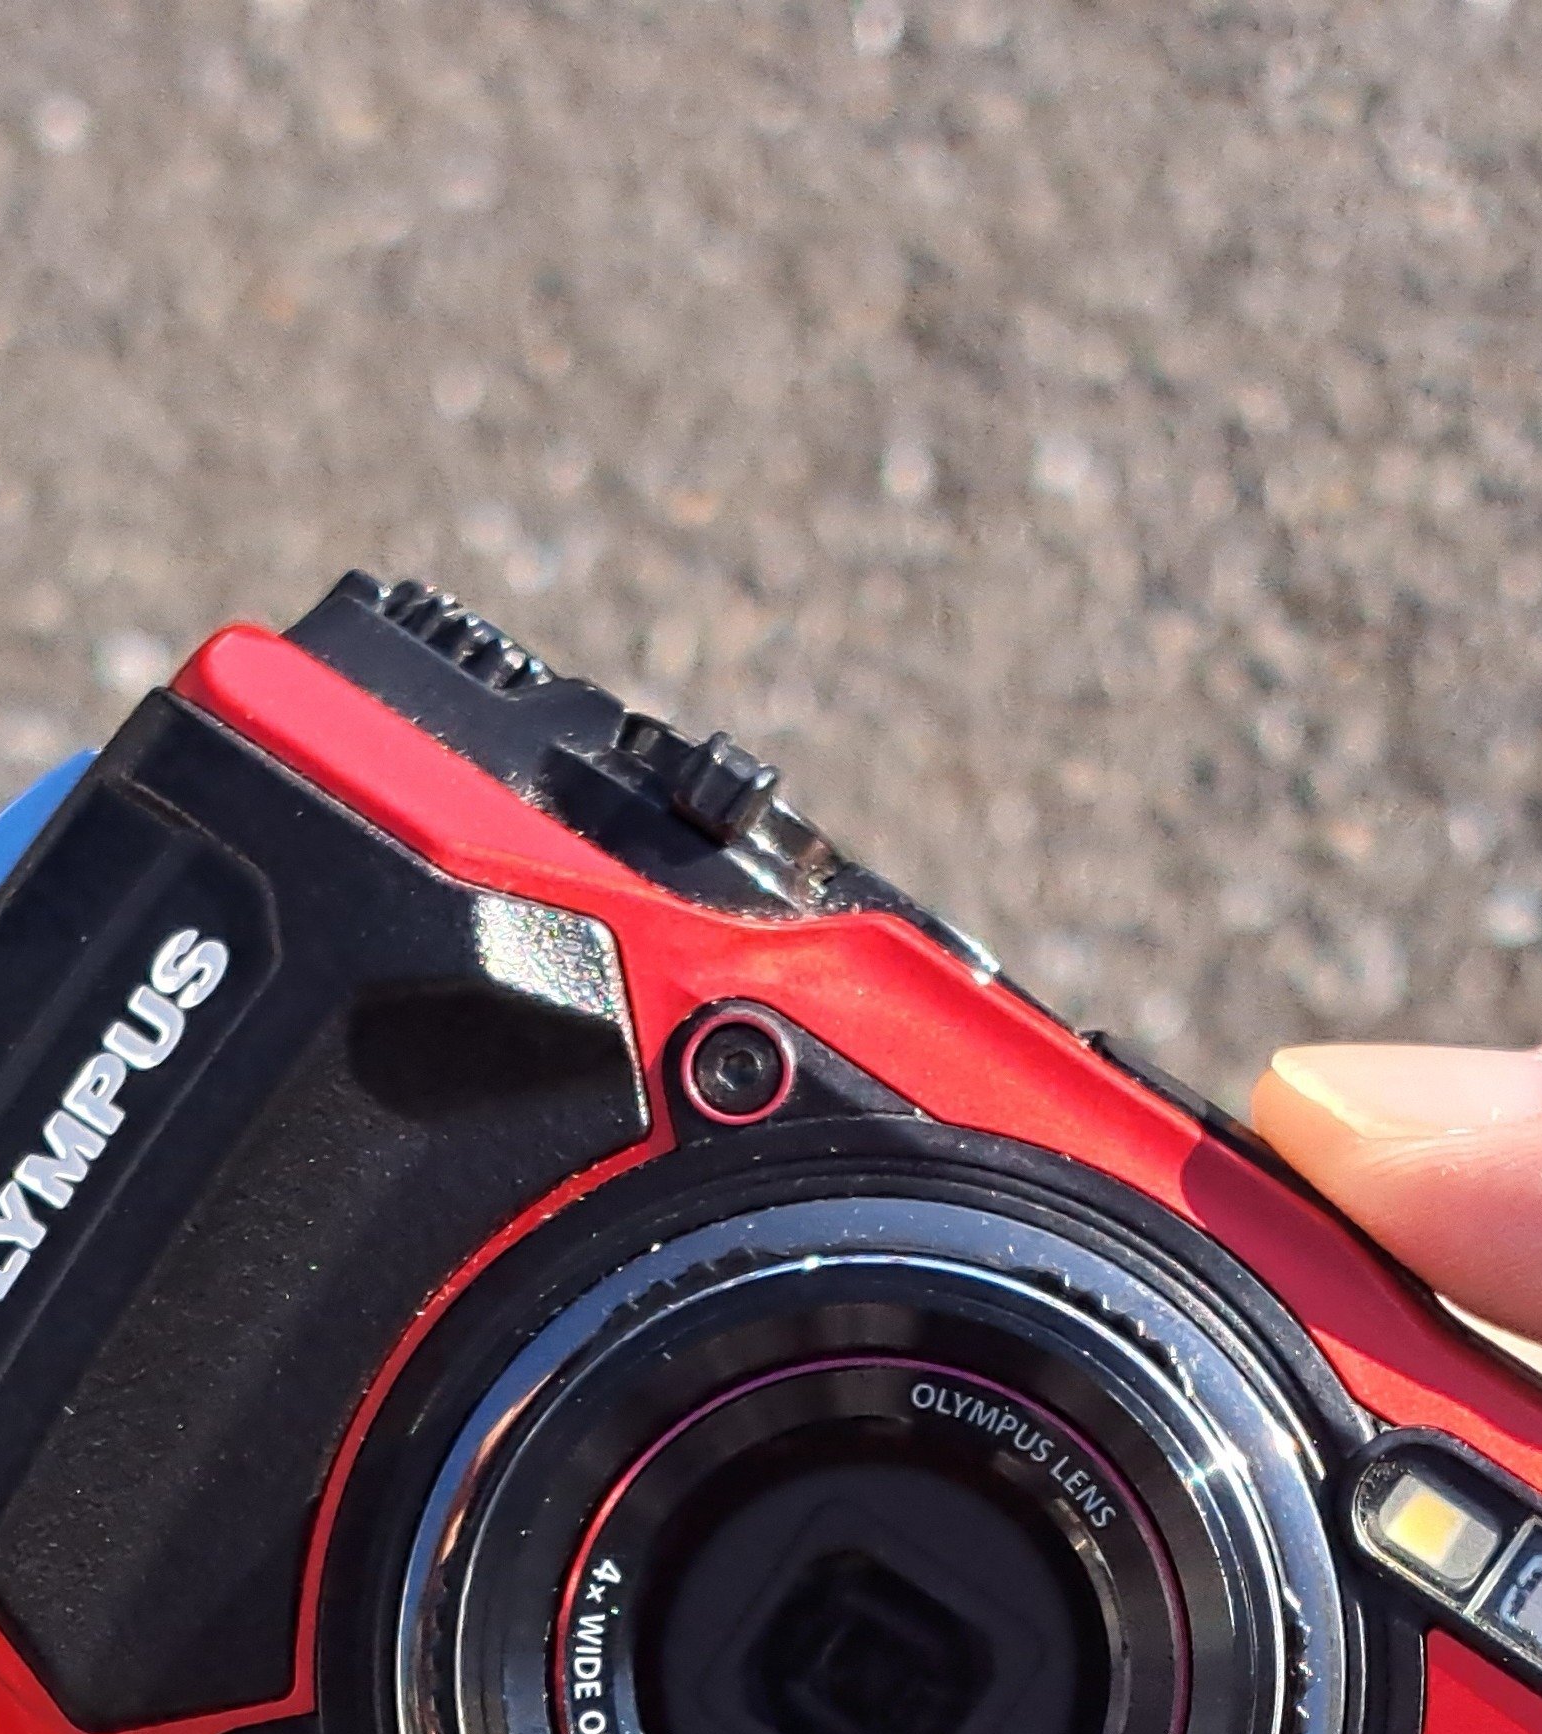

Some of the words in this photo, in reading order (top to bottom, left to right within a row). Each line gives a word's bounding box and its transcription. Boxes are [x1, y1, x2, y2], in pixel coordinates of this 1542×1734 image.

[911, 1382, 1055, 1462] OLYMPUS
[1049, 1456, 1116, 1528] LENS
[573, 1613, 607, 1700] WIDE
